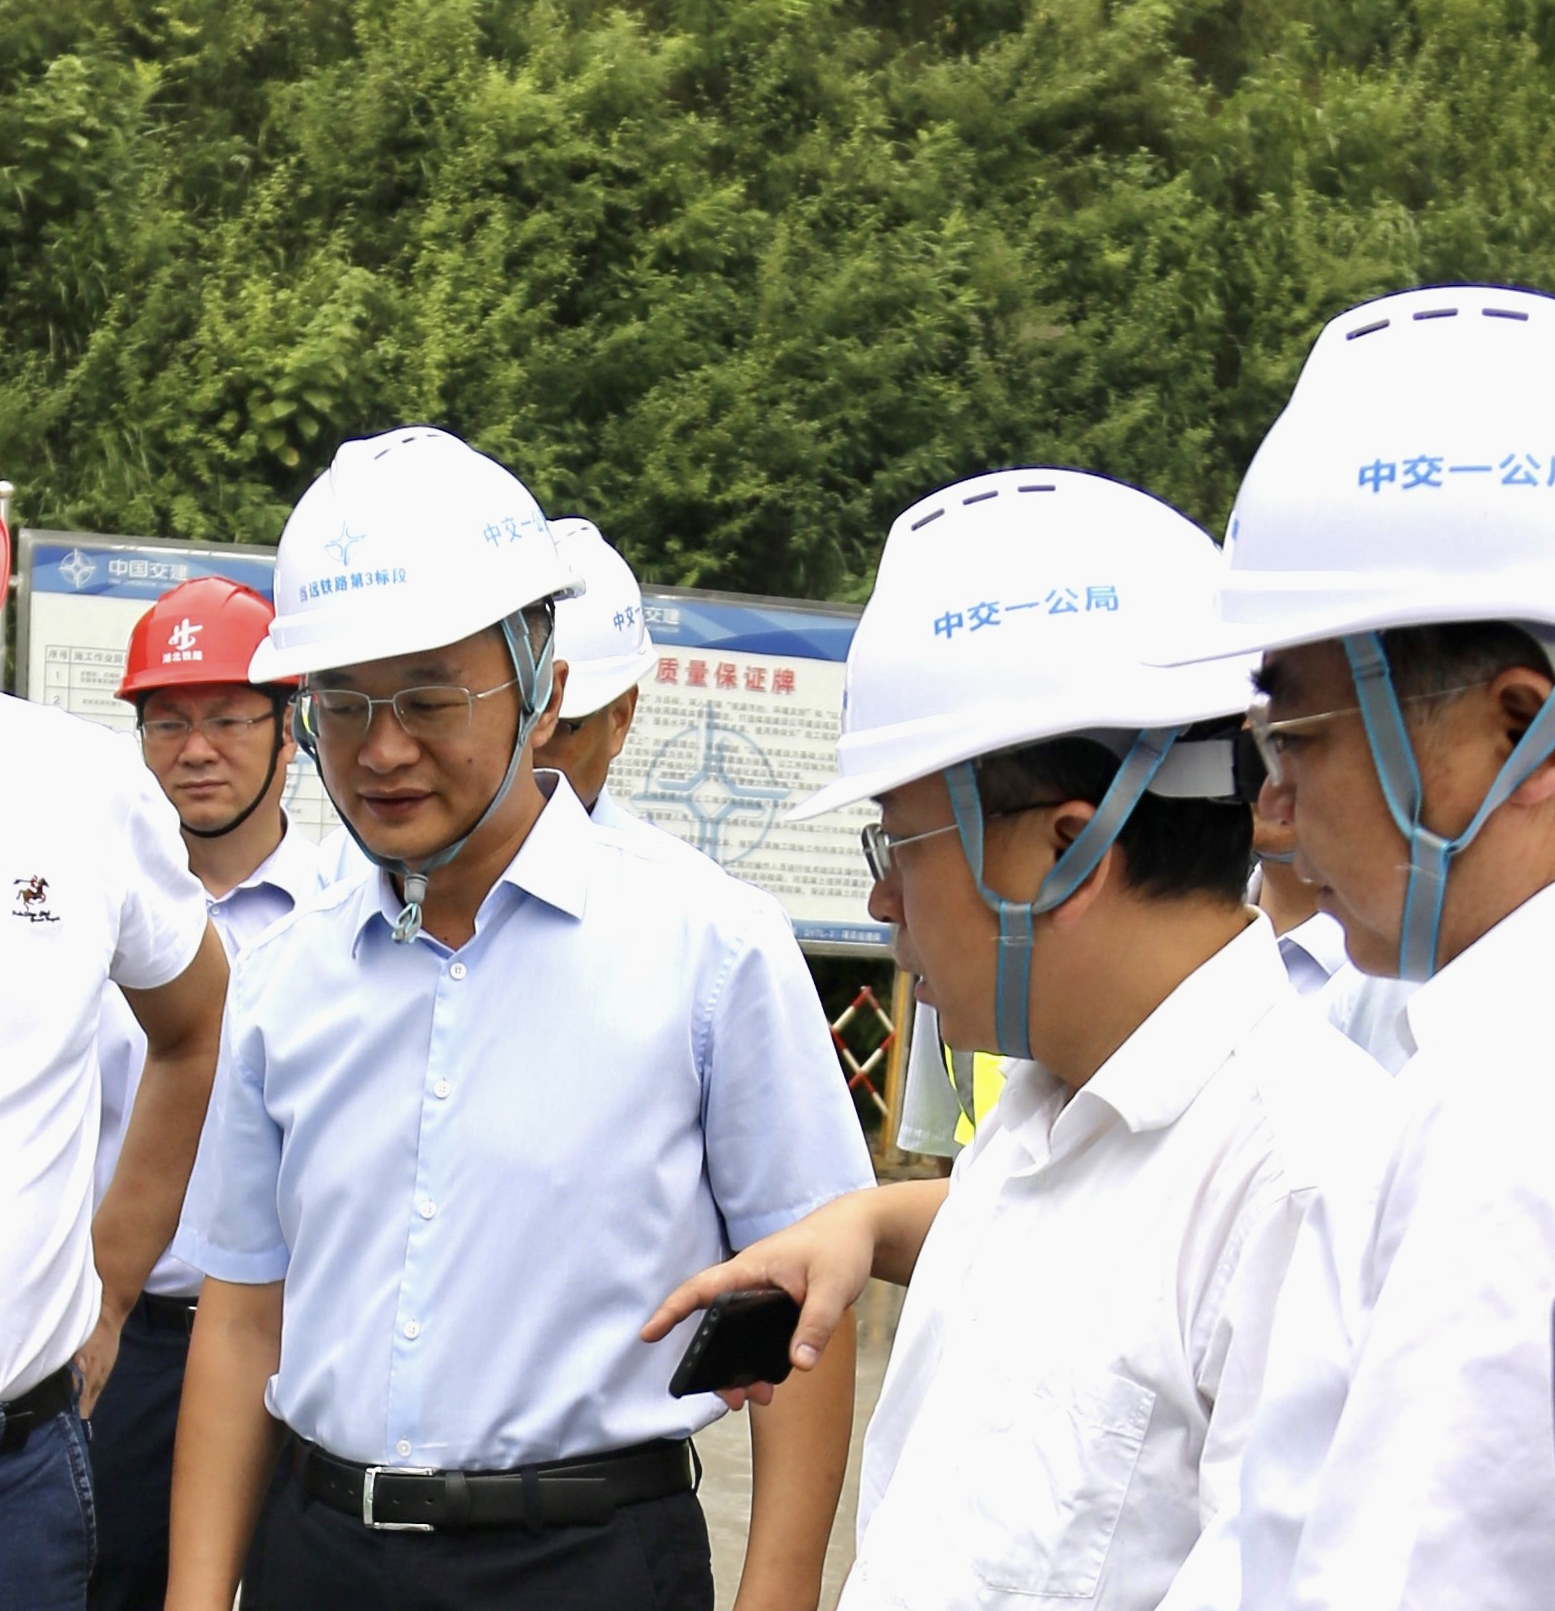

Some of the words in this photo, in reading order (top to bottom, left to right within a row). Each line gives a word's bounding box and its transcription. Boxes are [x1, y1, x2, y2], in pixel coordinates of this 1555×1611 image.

[108, 558, 189, 580] 中国交建
[933, 585, 1120, 640] 中交一公局
[162, 650, 203, 664] 湖北铁路
[654, 657, 797, 695] 质量保证牌
